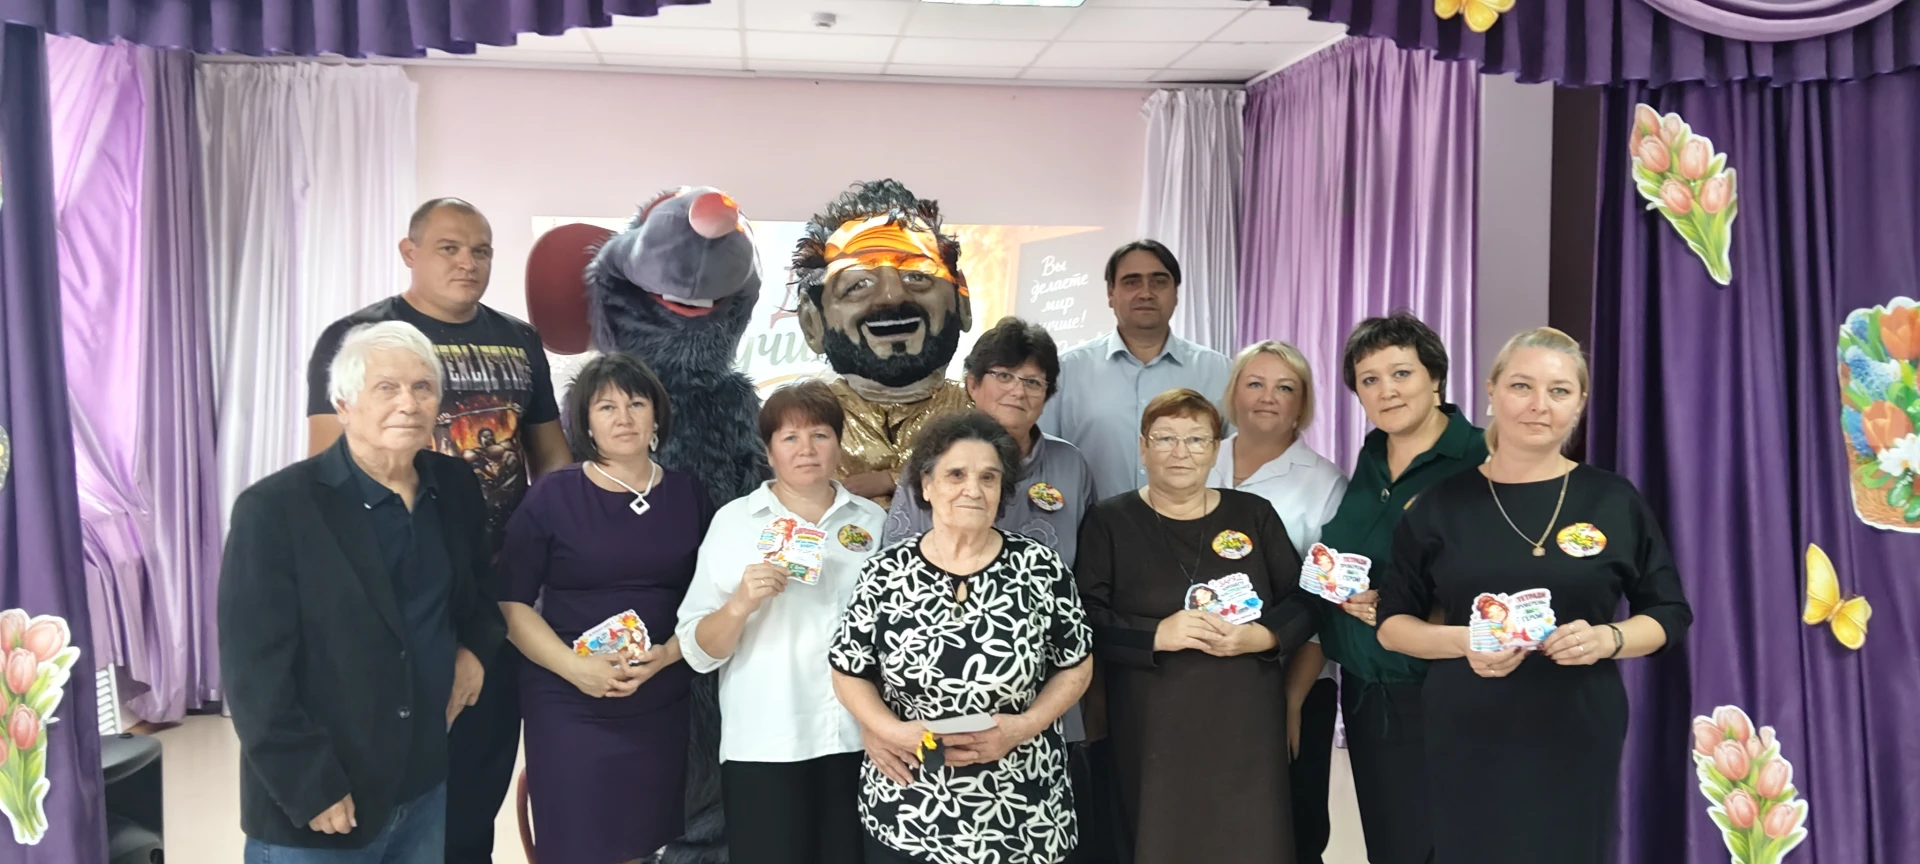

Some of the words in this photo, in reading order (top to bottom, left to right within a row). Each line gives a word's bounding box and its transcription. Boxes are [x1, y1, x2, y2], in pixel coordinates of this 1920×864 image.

[1040, 255, 1067, 276] Вы
[1030, 272, 1089, 303] делаете
[1041, 297, 1075, 316] мир
[1039, 309, 1088, 332] учше!
[433, 343, 534, 392] ERLIFTING
[1516, 592, 1547, 602] ТЕТРАДИ
